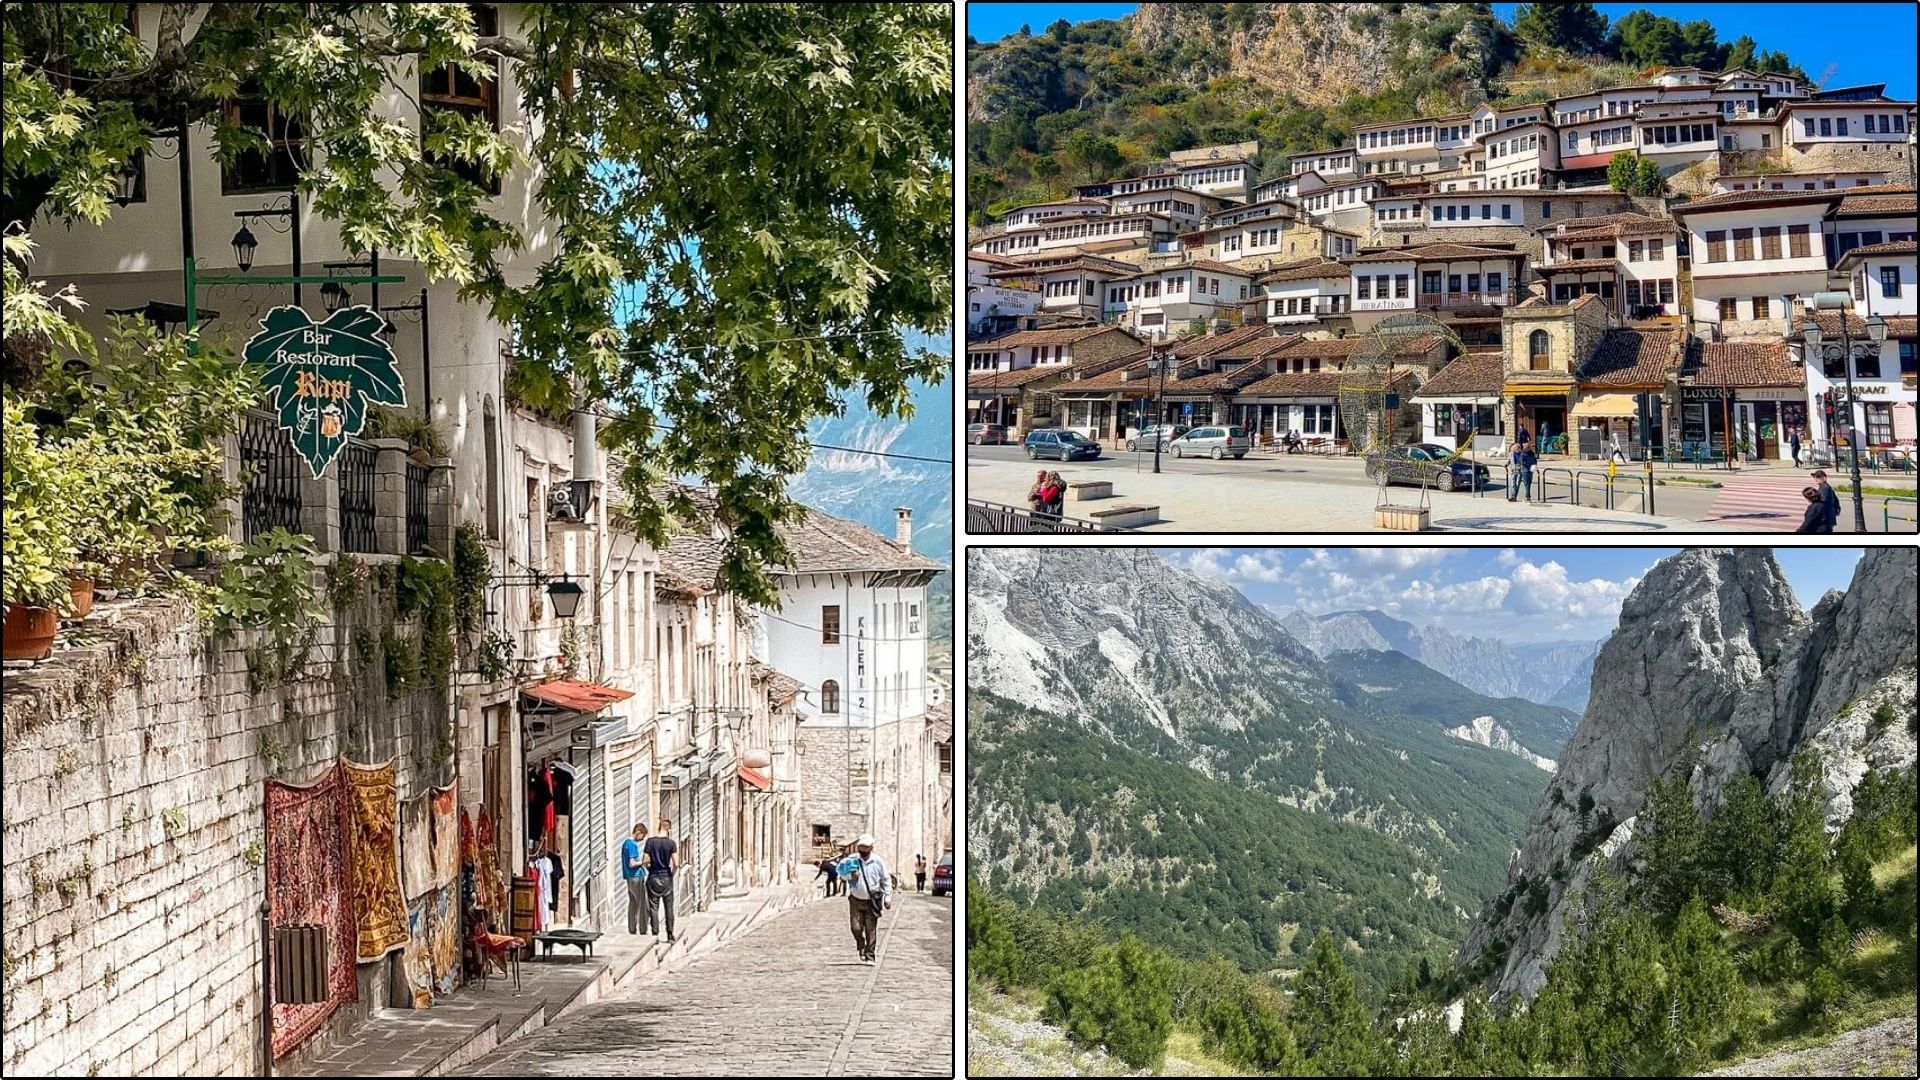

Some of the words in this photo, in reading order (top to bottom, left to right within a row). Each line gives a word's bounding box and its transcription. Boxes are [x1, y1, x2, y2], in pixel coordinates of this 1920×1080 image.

[303, 330, 332, 345] Bar
[276, 350, 356, 367] Restorant
[1683, 388, 1733, 398] LUXURY
[1828, 386, 1887, 395] RESORANT
[857, 616, 865, 689] KALEMI
[858, 697, 865, 708] 2
